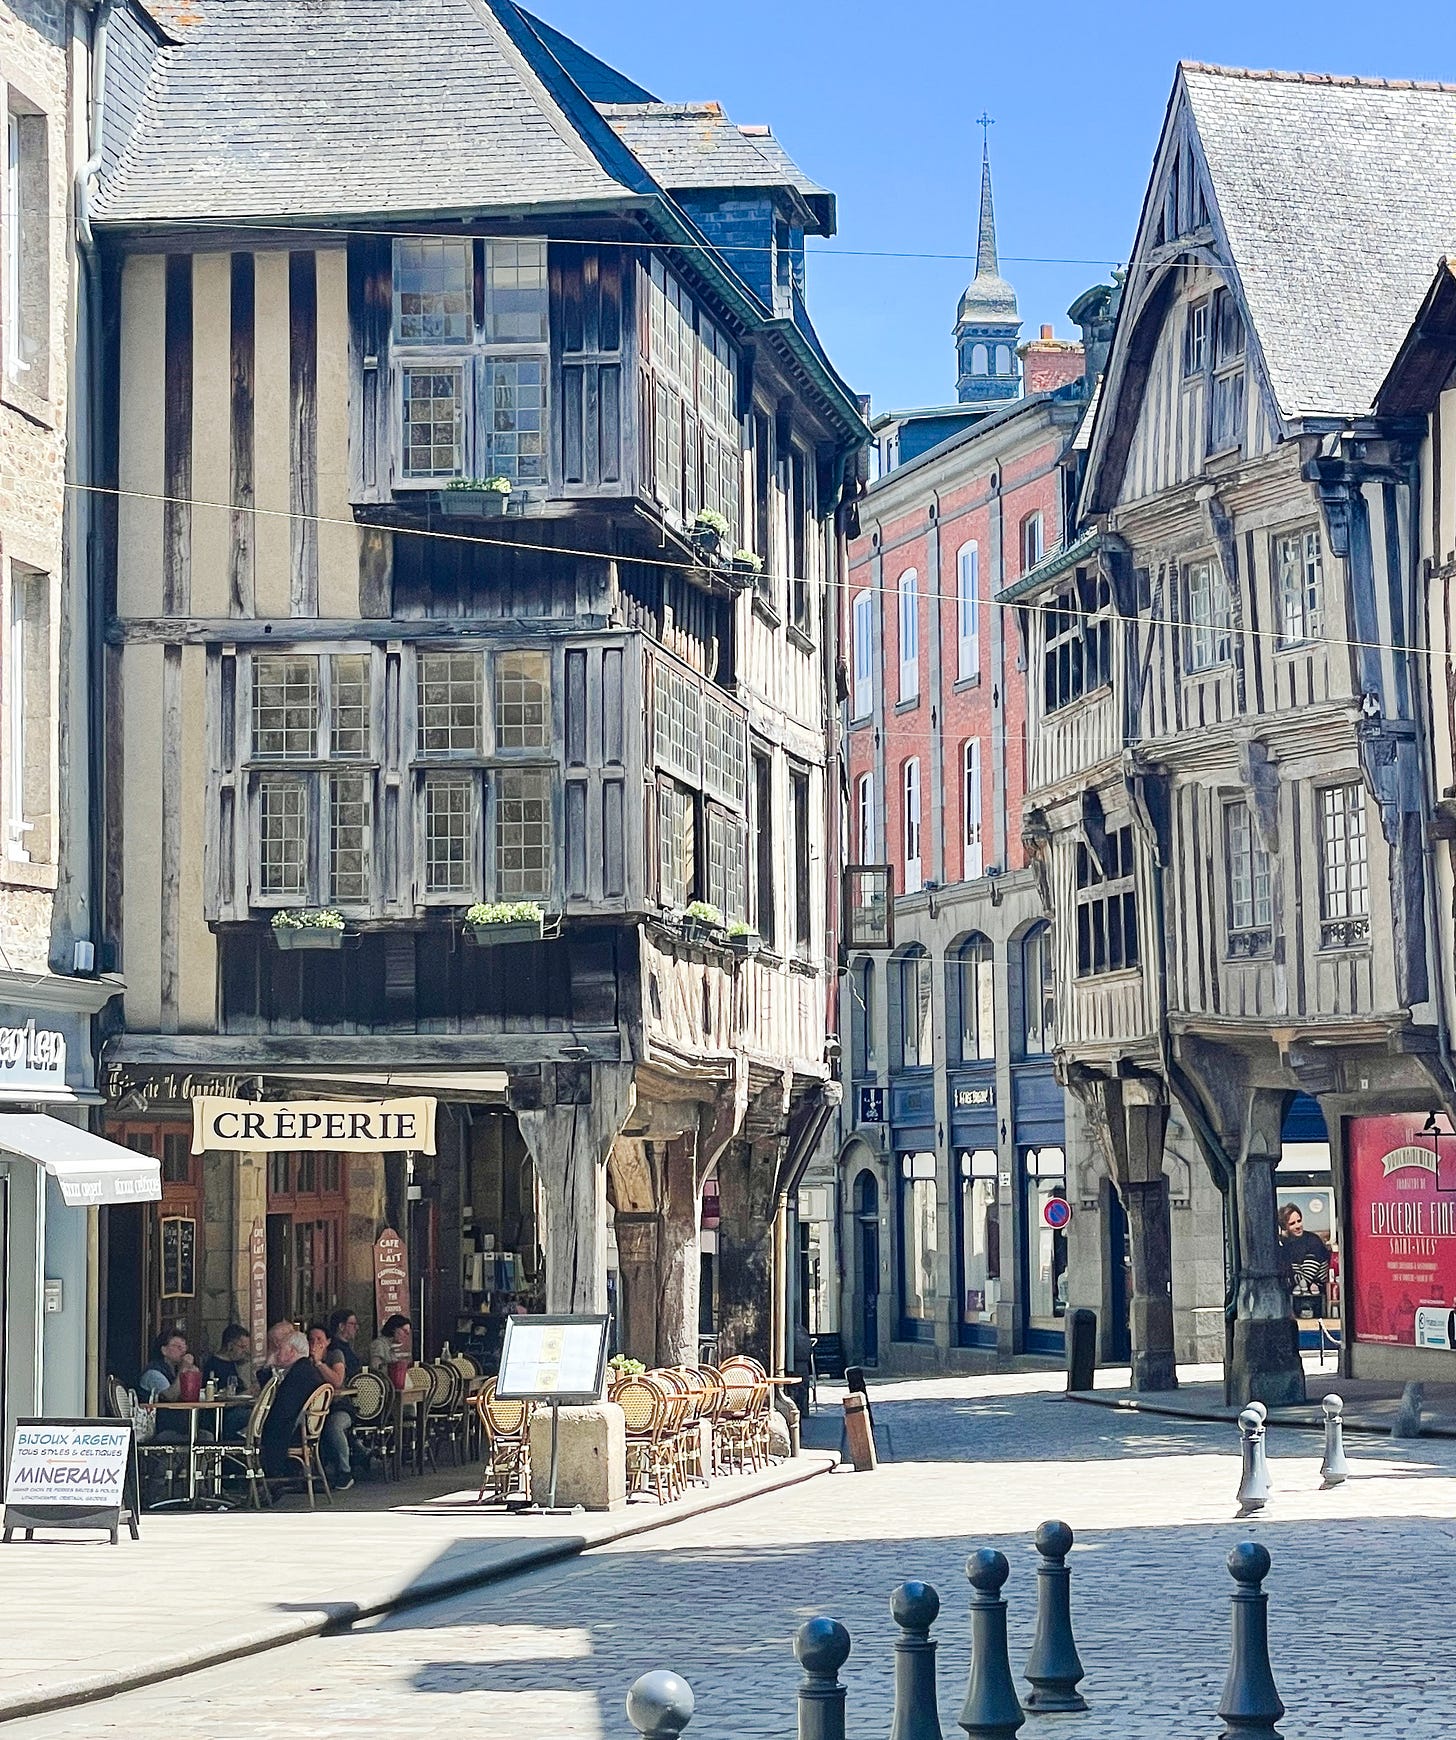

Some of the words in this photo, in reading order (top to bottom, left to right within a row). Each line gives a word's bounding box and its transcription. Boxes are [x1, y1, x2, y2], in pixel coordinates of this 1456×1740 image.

[213, 1108, 416, 1139] CRÊPERIE
[1371, 1202, 1423, 1234] EPICERIE
[380, 1253, 402, 1262] LAIT
[18, 1434, 69, 1445] BIJOUX
[72, 1435, 127, 1446] ARGENT
[80, 1449, 122, 1457] CELTIQUES
[15, 1467, 120, 1484] MINERAUX
